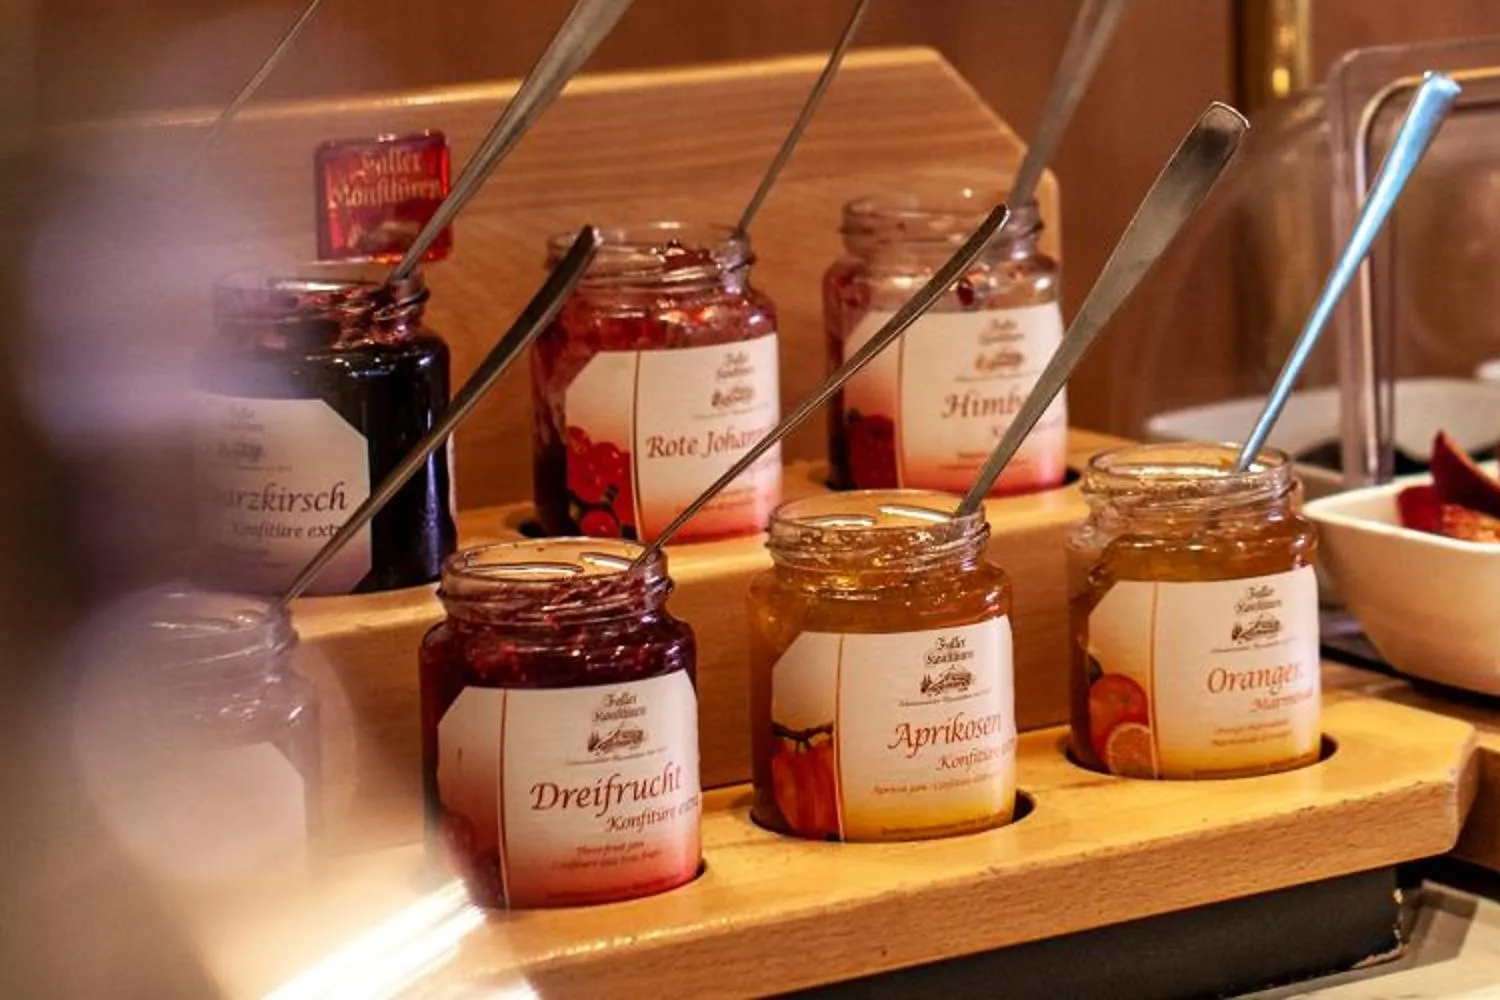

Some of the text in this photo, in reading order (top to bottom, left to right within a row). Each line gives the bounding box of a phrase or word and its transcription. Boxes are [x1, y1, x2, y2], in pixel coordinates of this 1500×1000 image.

[941, 384, 1023, 419] Himb
[645, 433, 698, 459] Rote
[307, 522, 343, 539] ext
[887, 711, 1001, 759] Aprikosen
[529, 762, 682, 818] Dreifrucht
